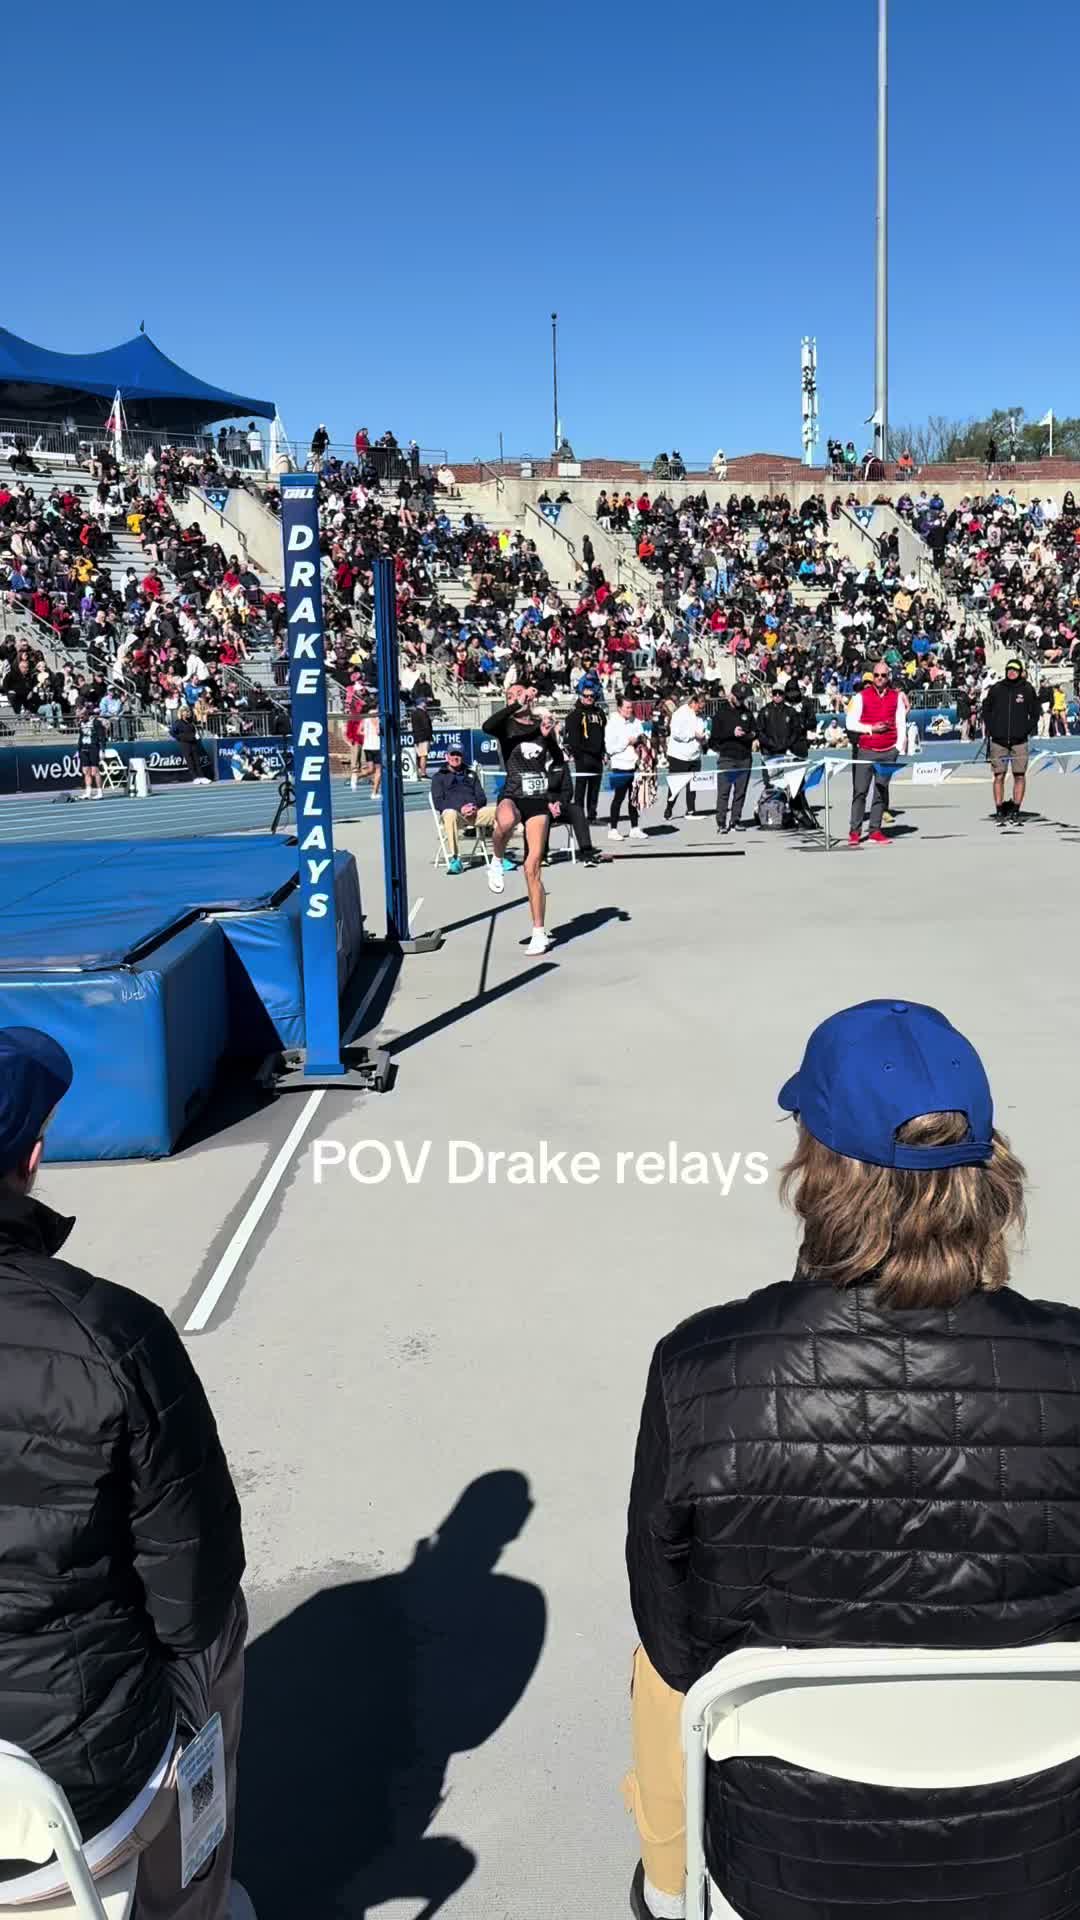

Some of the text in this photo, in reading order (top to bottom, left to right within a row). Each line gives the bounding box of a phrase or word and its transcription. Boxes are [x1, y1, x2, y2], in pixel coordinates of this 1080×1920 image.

[283, 488, 314, 499] GILL
[287, 524, 331, 918] DRAKE RELAYS
[443, 733, 461, 744] THE
[149, 752, 182, 767] Drake
[402, 758, 410, 772] 6
